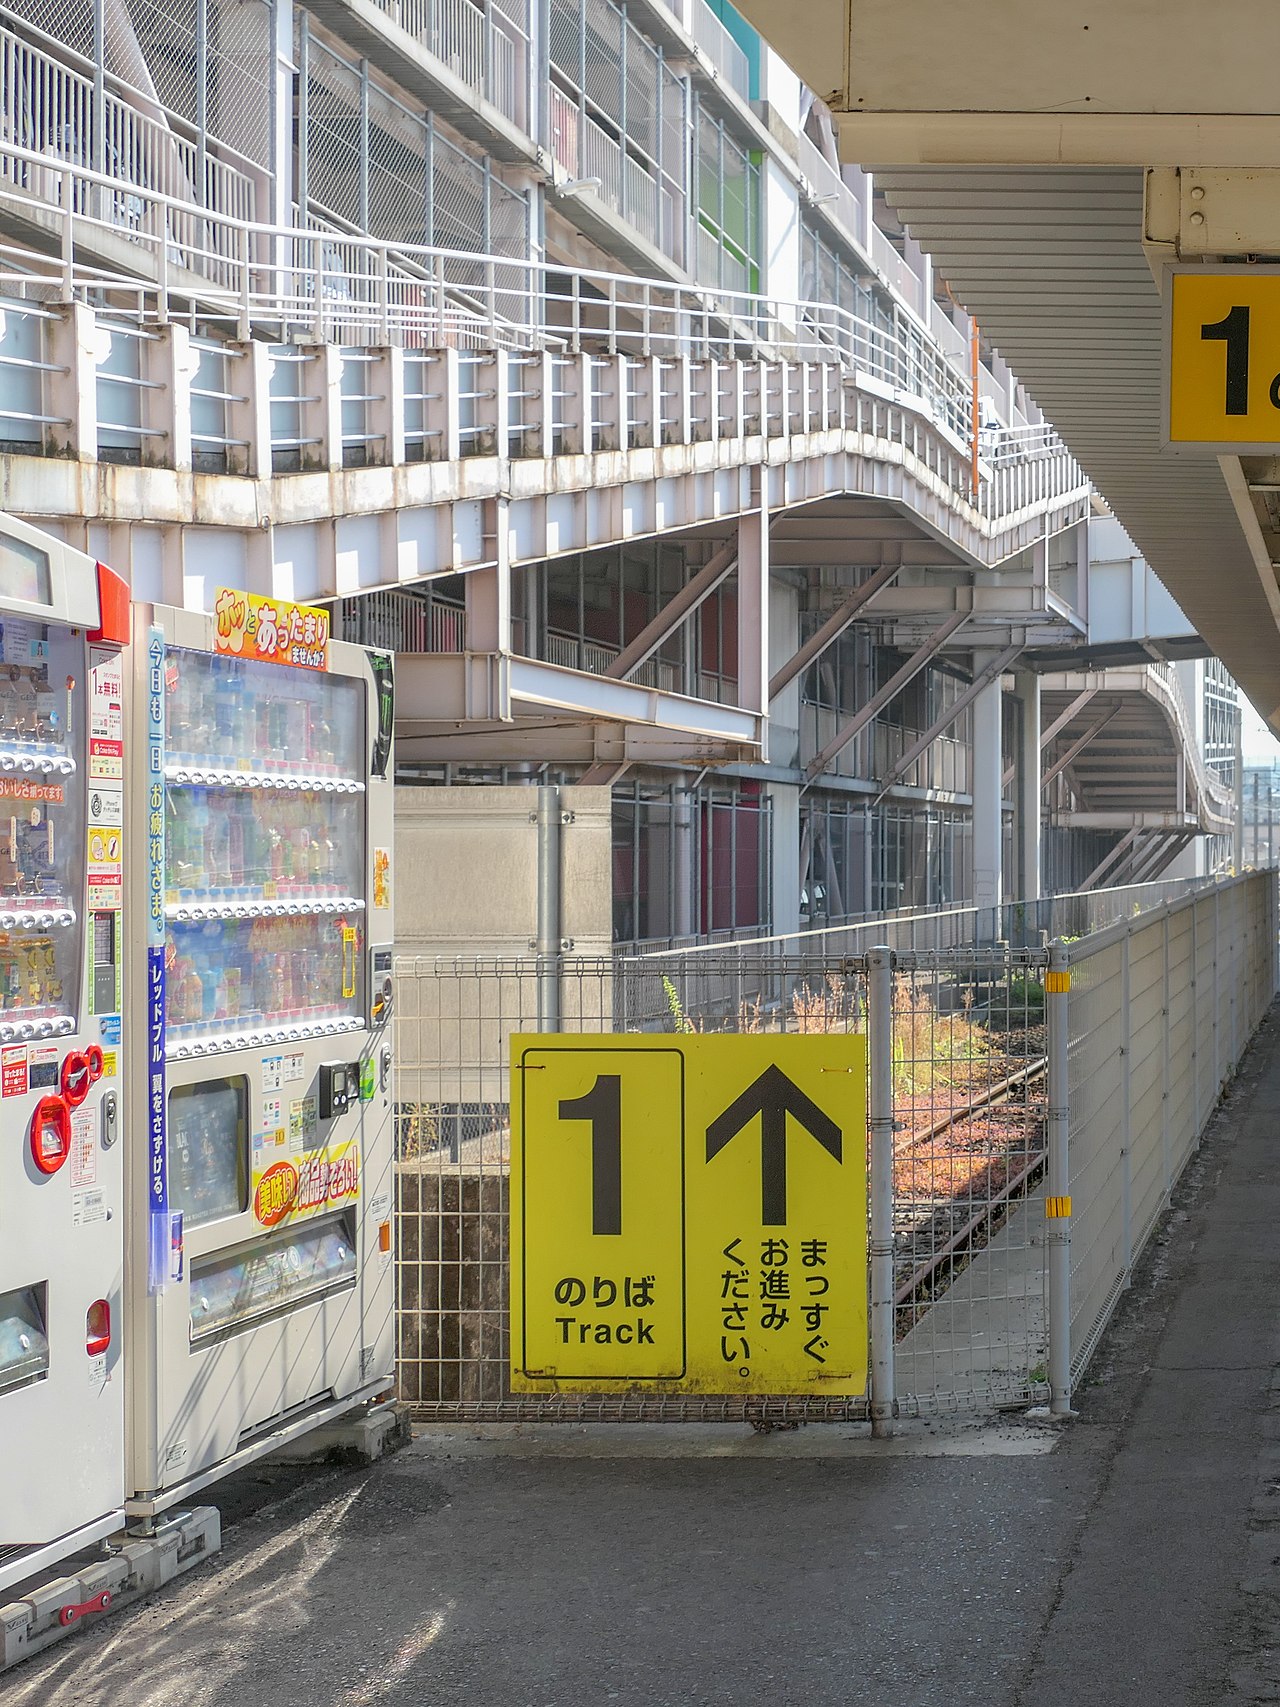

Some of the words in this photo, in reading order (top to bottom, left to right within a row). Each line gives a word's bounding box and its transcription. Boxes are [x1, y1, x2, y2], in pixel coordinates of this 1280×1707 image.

[149, 639, 163, 723] 今日も
[149, 732, 163, 773] 一日
[152, 965, 163, 1063] レッドブル
[558, 1074, 622, 1236] 1
[554, 1276, 655, 1308] のりば
[555, 1317, 655, 1344] Track
[721, 1238, 750, 1378] ください。
[759, 1238, 790, 1331] お進み
[800, 1238, 829, 1364] まっすぐ
